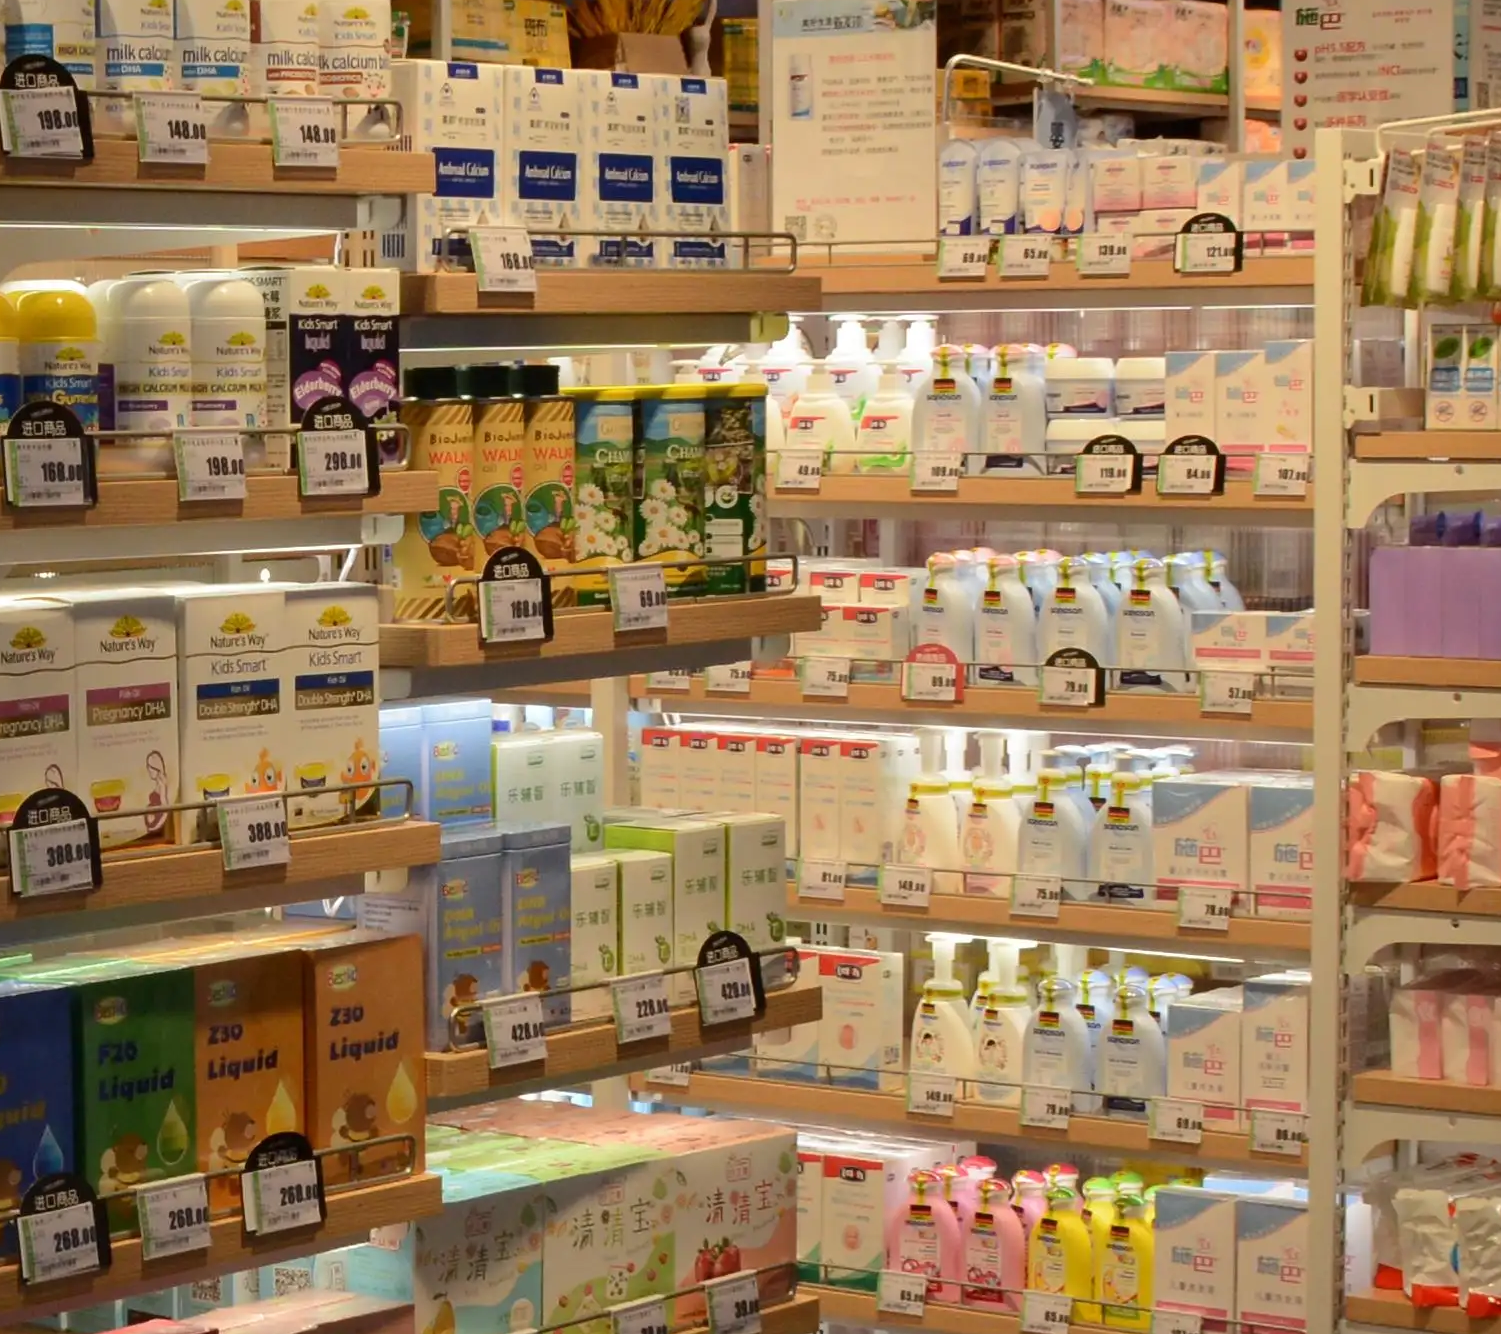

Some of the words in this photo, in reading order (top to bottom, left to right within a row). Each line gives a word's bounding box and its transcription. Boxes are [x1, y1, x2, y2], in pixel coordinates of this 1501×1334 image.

[106, 44, 136, 62] milk
[182, 48, 212, 63] milk
[298, 319, 312, 330] Kids
[312, 319, 337, 331] Smart
[354, 319, 368, 331] Kids
[369, 319, 392, 331] Smart
[210, 635, 245, 649] Nature's
[247, 633, 266, 649] Way
[308, 627, 340, 641] Nature's
[342, 626, 362, 641] Way
[100, 639, 133, 653] Nature's
[136, 637, 156, 652] Way
[1, 650, 33, 664] Nature's
[35, 649, 56, 664] Way
[309, 652, 330, 667] Kids
[333, 651, 362, 665] Smart
[211, 660, 234, 675] Kids
[236, 658, 266, 673] Smart
[93, 704, 143, 722] Pregnancy
[145, 701, 166, 717] DHA
[329, 1006, 364, 1028] Z30
[207, 1024, 244, 1046] Z30
[329, 1029, 400, 1062] Liquid
[207, 1048, 280, 1082] Liquid
[99, 1067, 176, 1102] Liquid
